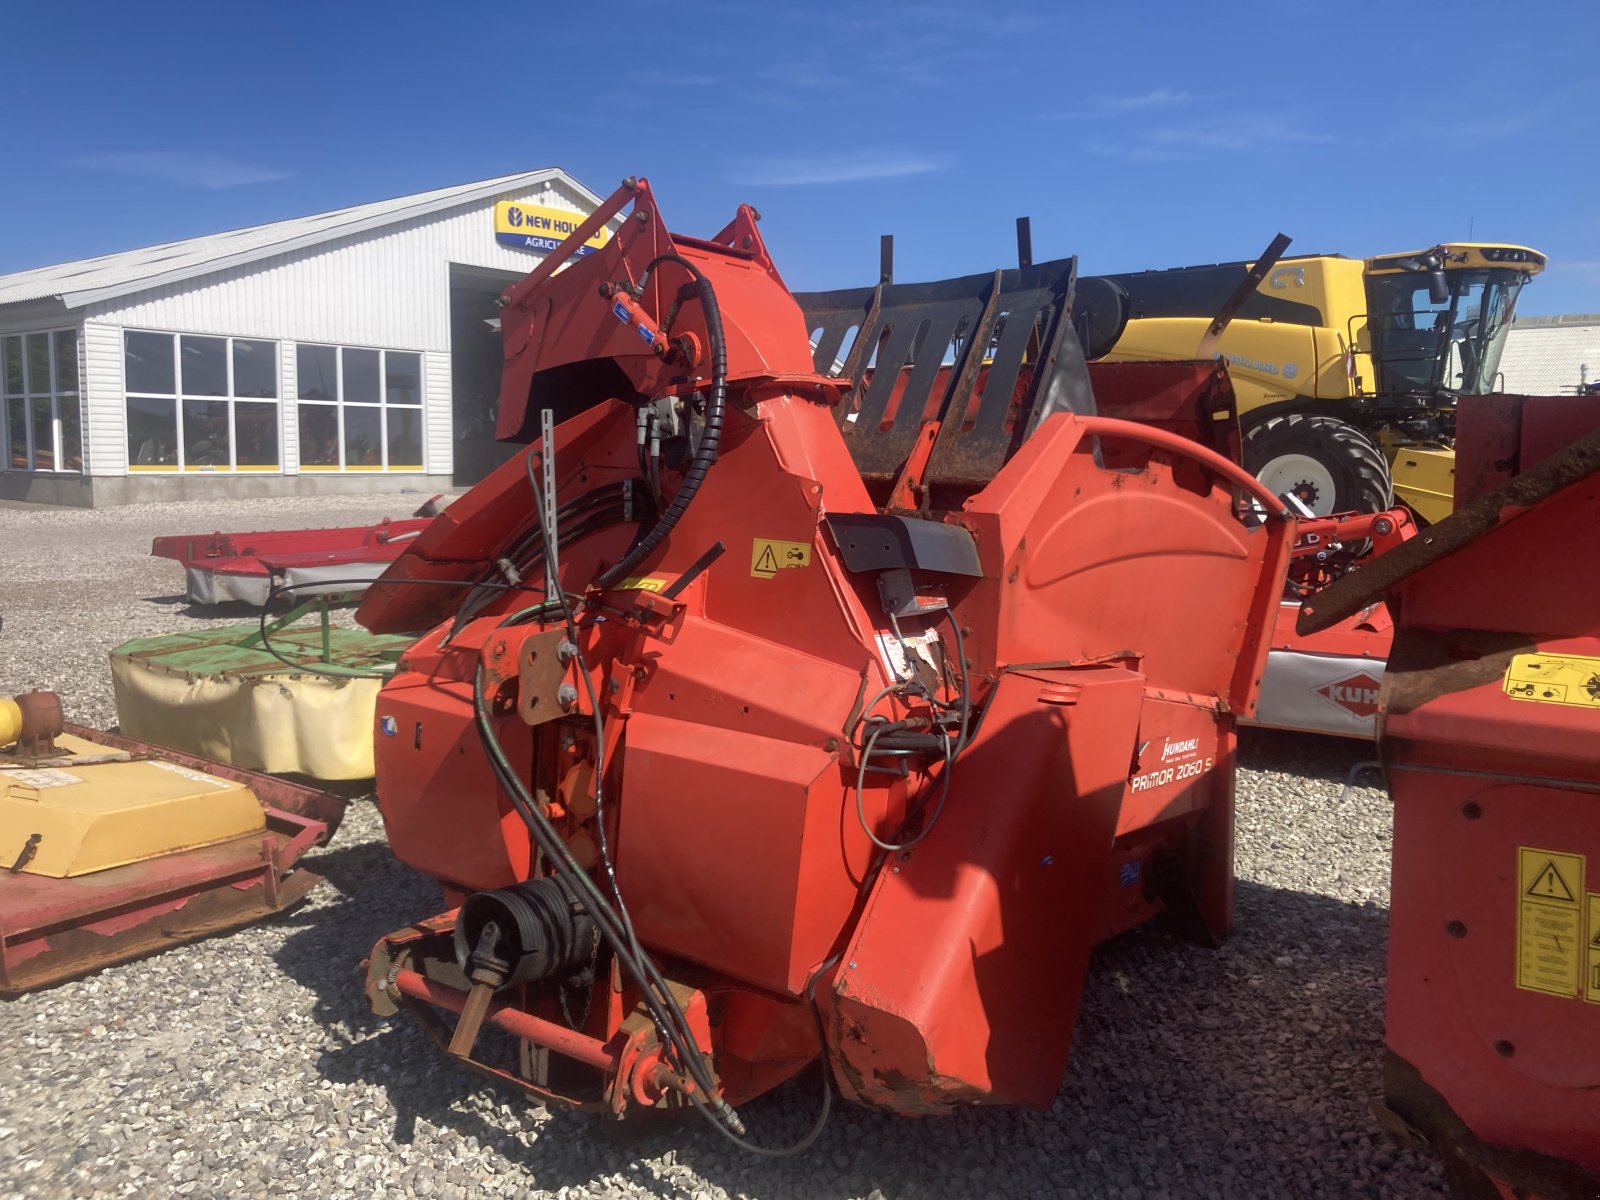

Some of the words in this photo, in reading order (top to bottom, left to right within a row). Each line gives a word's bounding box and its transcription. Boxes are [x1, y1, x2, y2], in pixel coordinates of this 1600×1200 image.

[526, 215, 551, 230] NEW
[554, 219, 600, 239] HOLD
[1270, 266, 1305, 289] CR
[1131, 768, 1174, 794] PRIMOR
[1176, 759, 1203, 780] 2060
[1204, 757, 1213, 773] S
